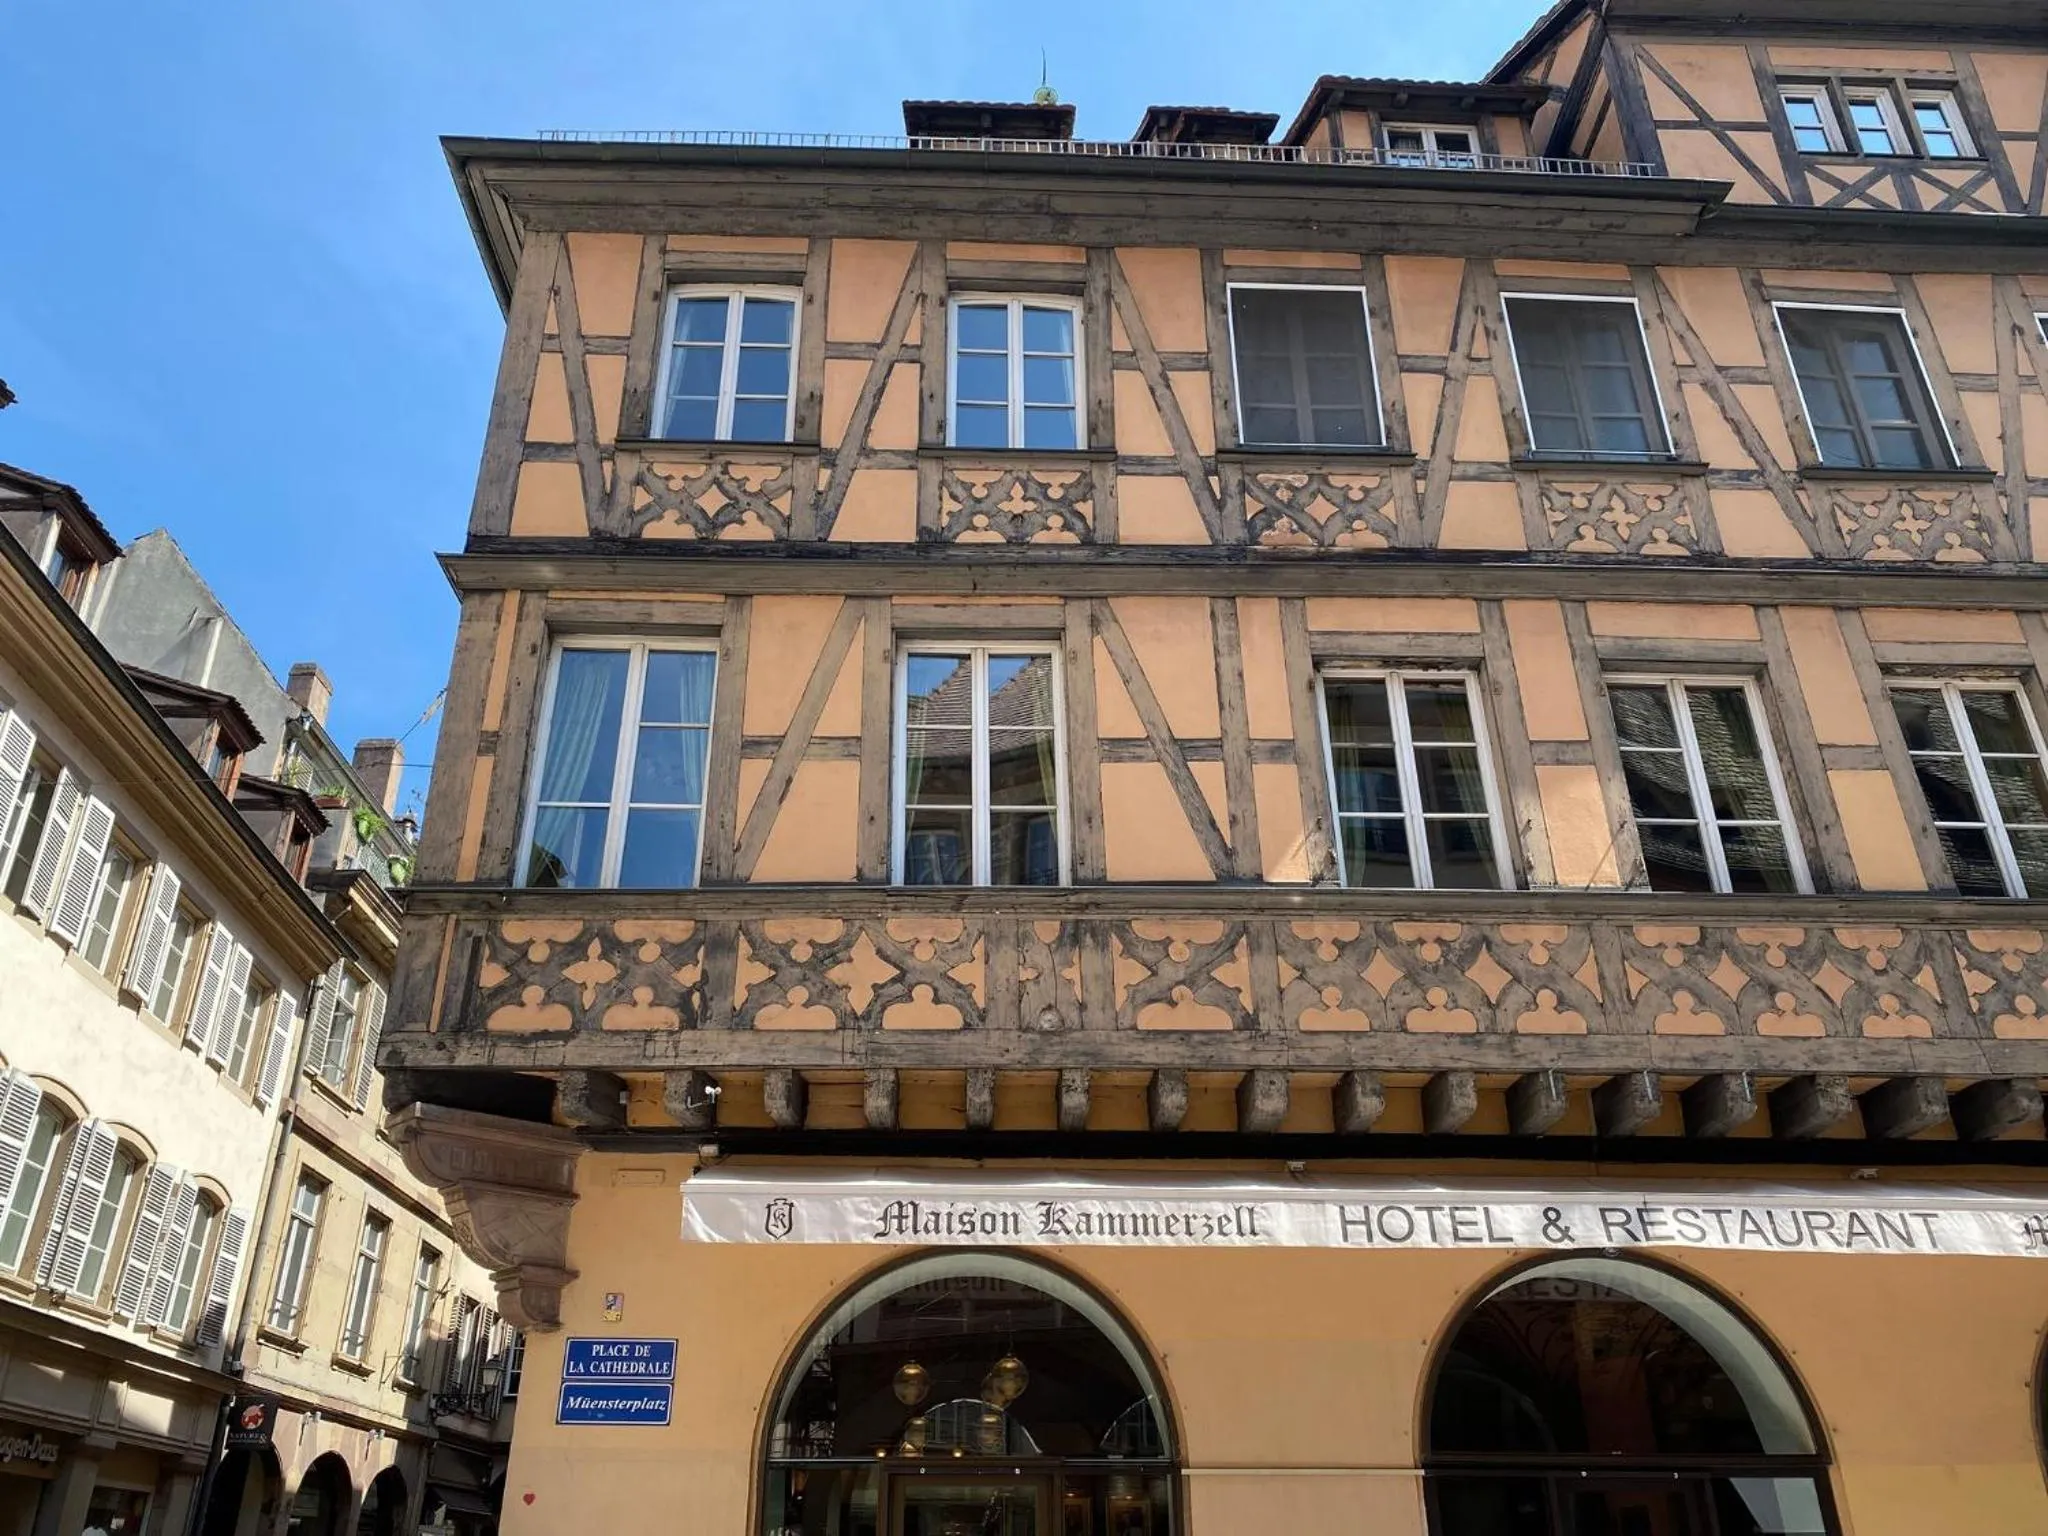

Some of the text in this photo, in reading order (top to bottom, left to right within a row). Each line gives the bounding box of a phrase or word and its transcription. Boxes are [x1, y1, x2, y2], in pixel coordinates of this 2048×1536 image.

[874, 1200, 1259, 1244] Maison Kammerzell
[1338, 1204, 1939, 1249] HOTEL & RESTAURANT
[591, 1344, 651, 1357] PLACE DE
[568, 1360, 670, 1375] LA CATHEDRALE
[566, 1396, 667, 1412] Müensterplatz
